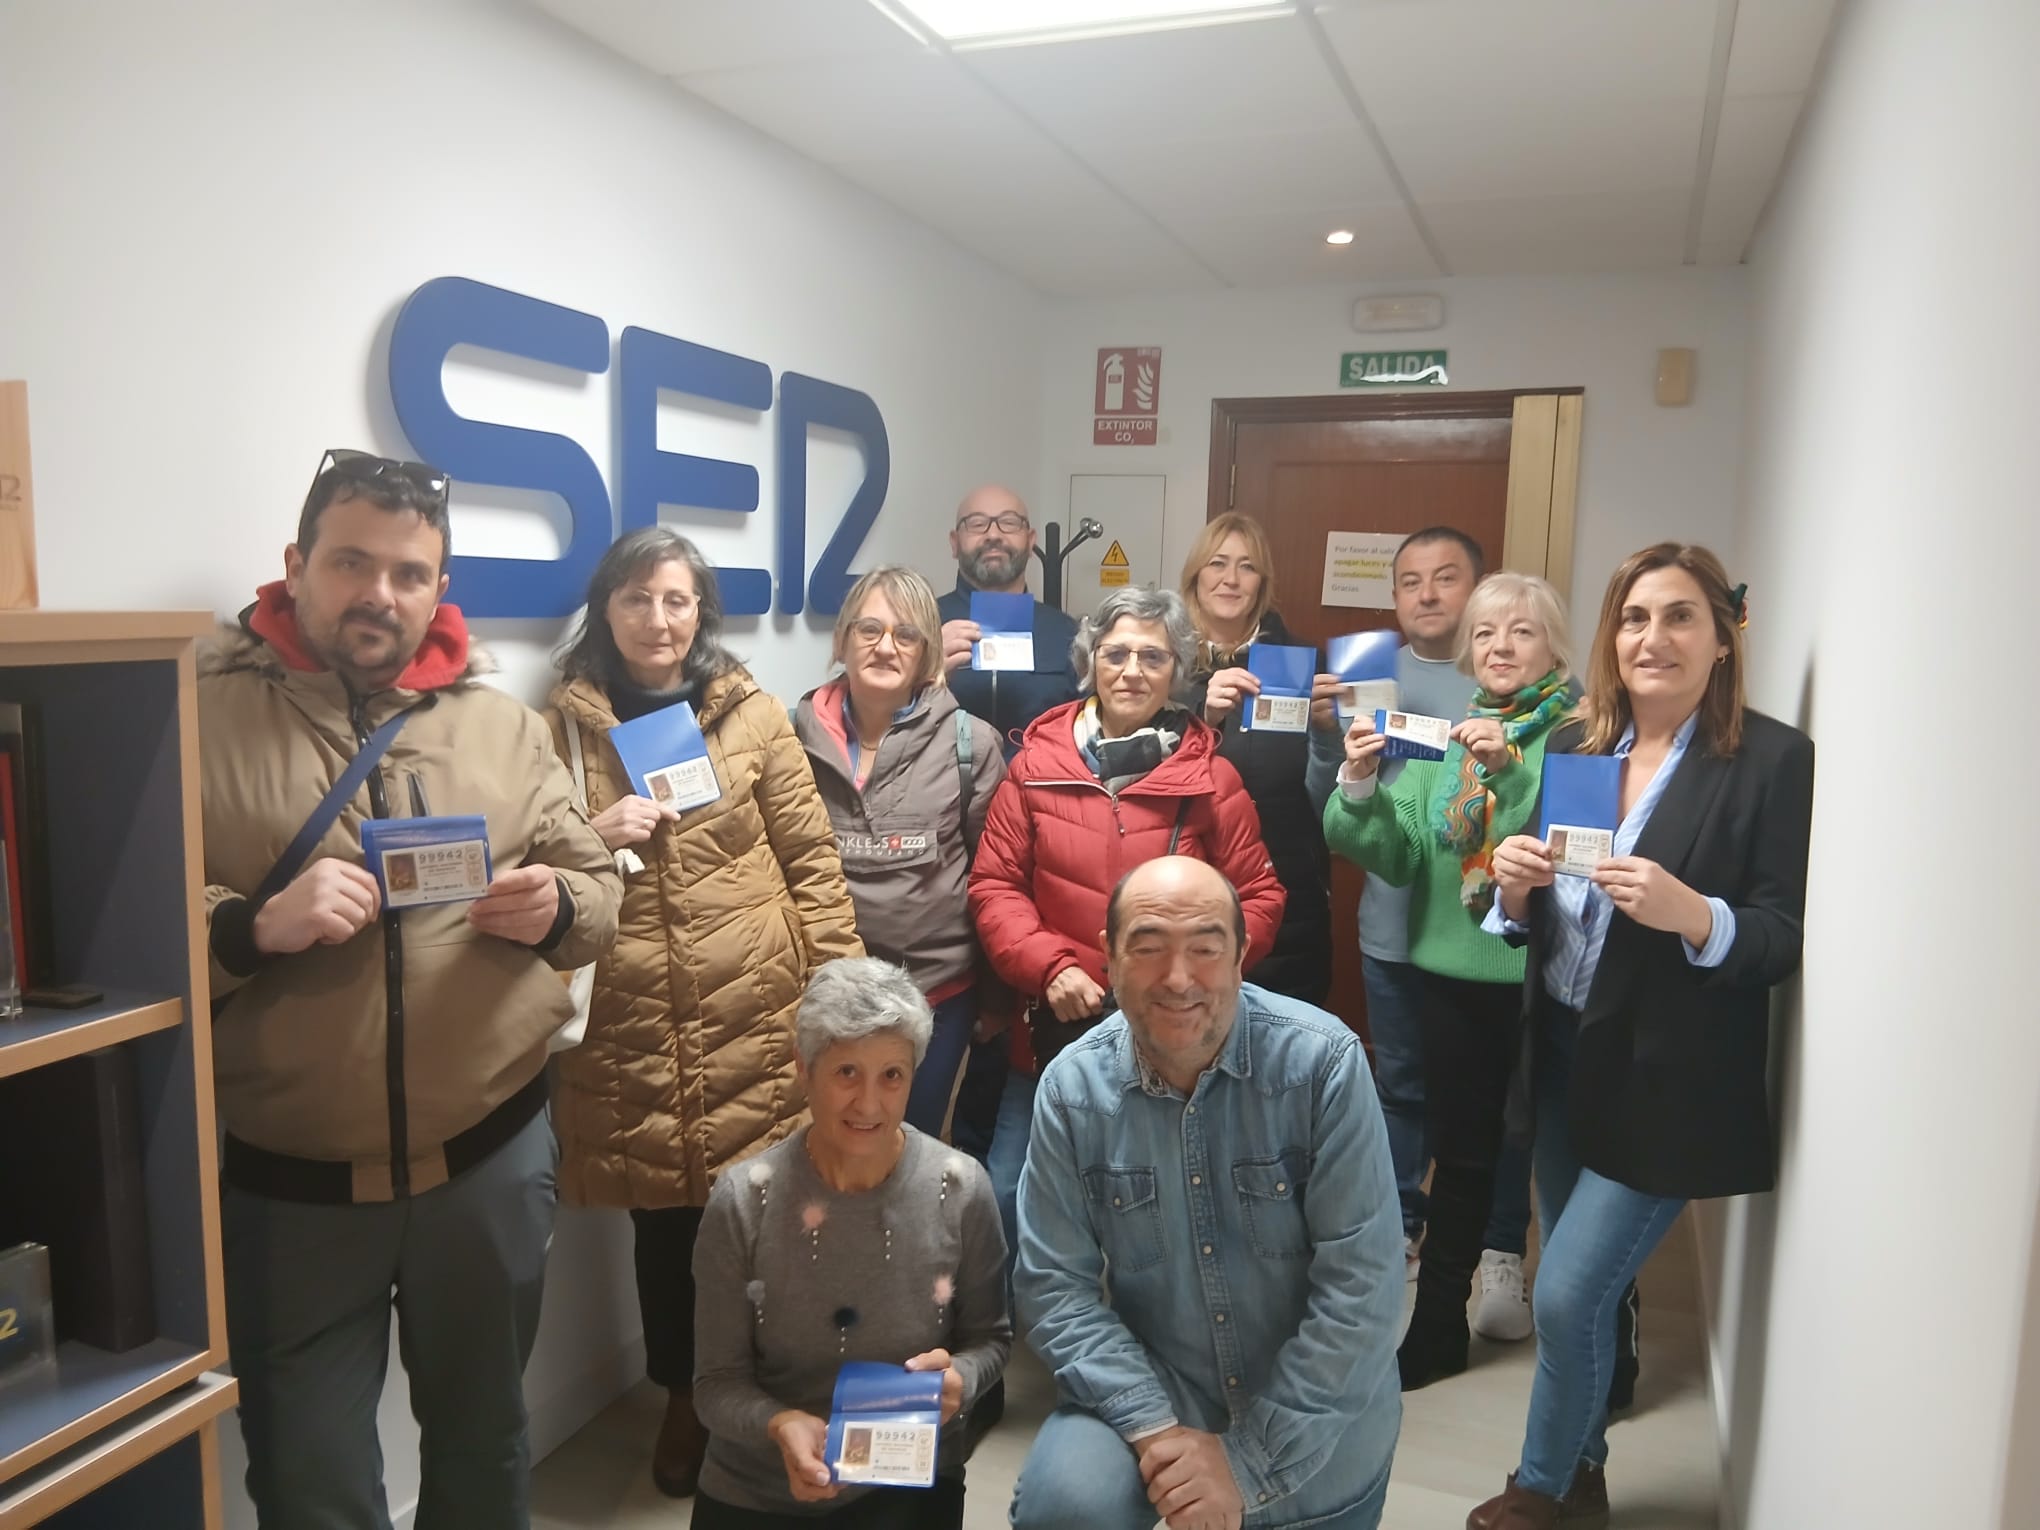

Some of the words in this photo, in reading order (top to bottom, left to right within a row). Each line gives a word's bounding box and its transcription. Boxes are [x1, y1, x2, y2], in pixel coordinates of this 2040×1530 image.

[1349, 355, 1440, 380] SALIDA
[1098, 420, 1152, 431] EXTINTOR
[389, 276, 890, 617] SER
[1331, 584, 1359, 592] Gracias
[419, 849, 462, 864] 99942
[876, 1431, 915, 1441] 99942
